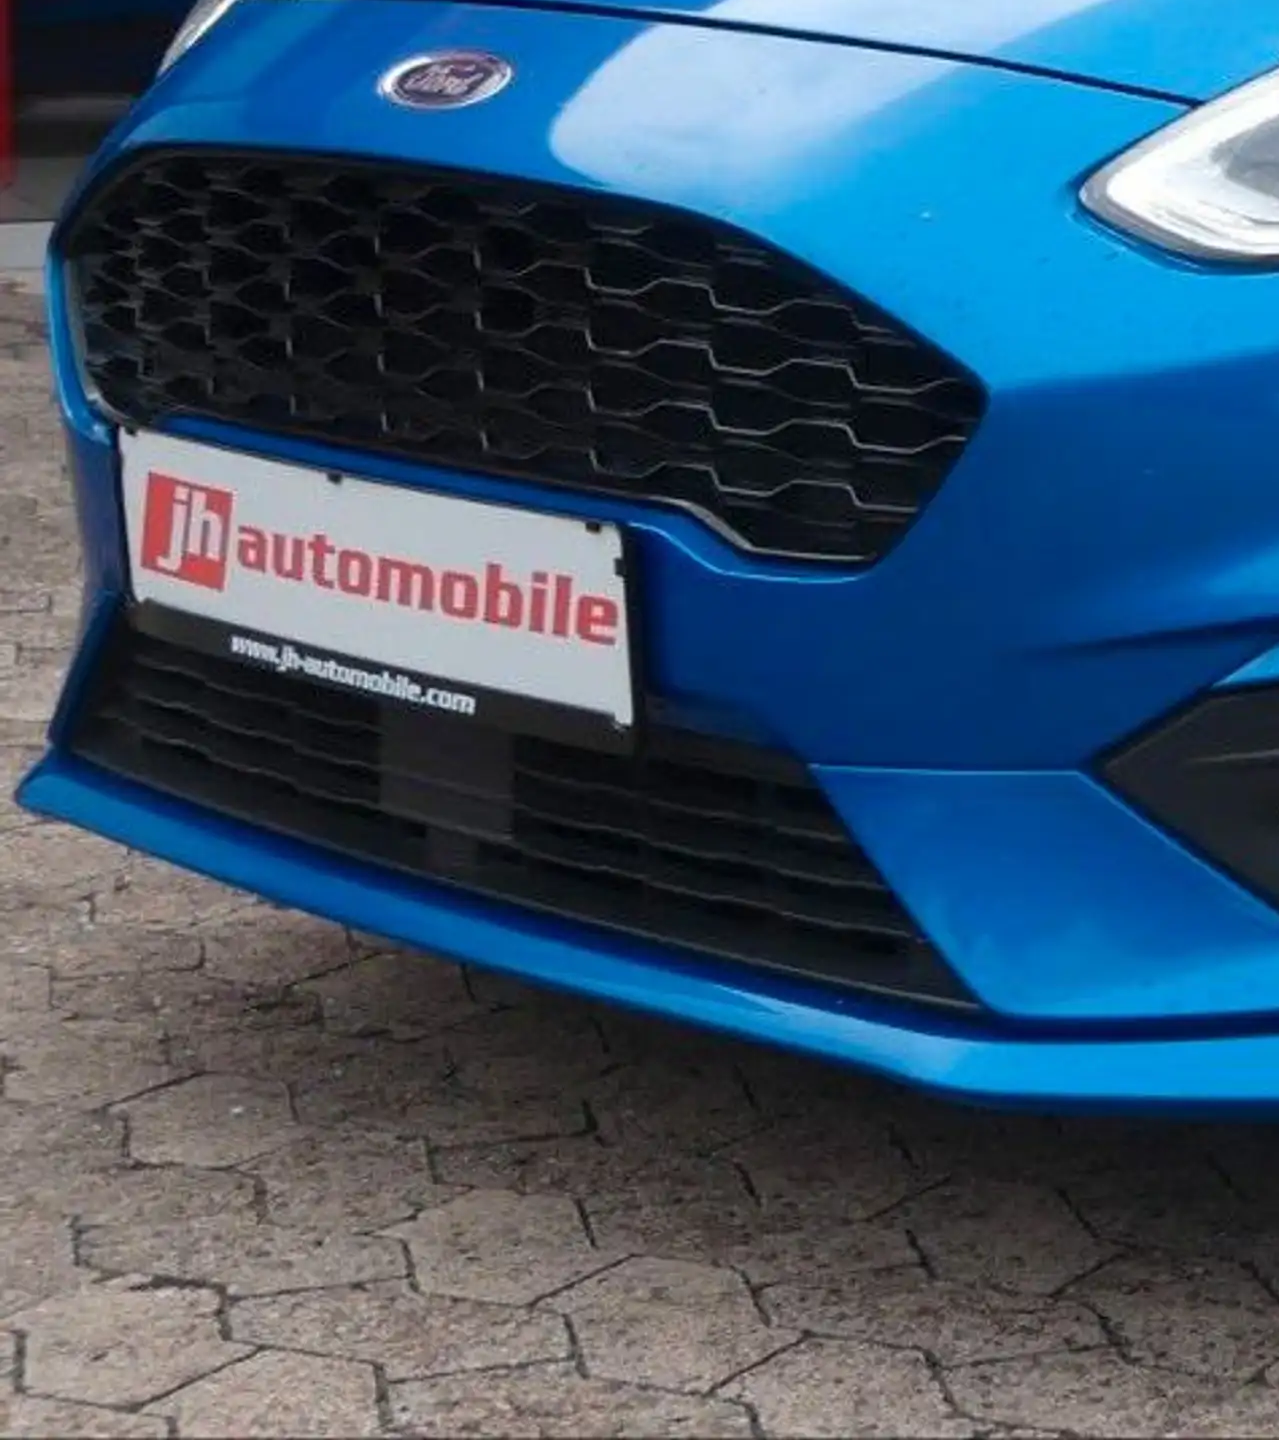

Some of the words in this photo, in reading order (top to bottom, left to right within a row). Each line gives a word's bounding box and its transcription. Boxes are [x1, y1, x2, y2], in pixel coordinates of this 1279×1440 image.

[402, 62, 485, 97] Ford
[236, 523, 621, 647] automobile
[230, 633, 476, 715] www.jh-automobile.com
